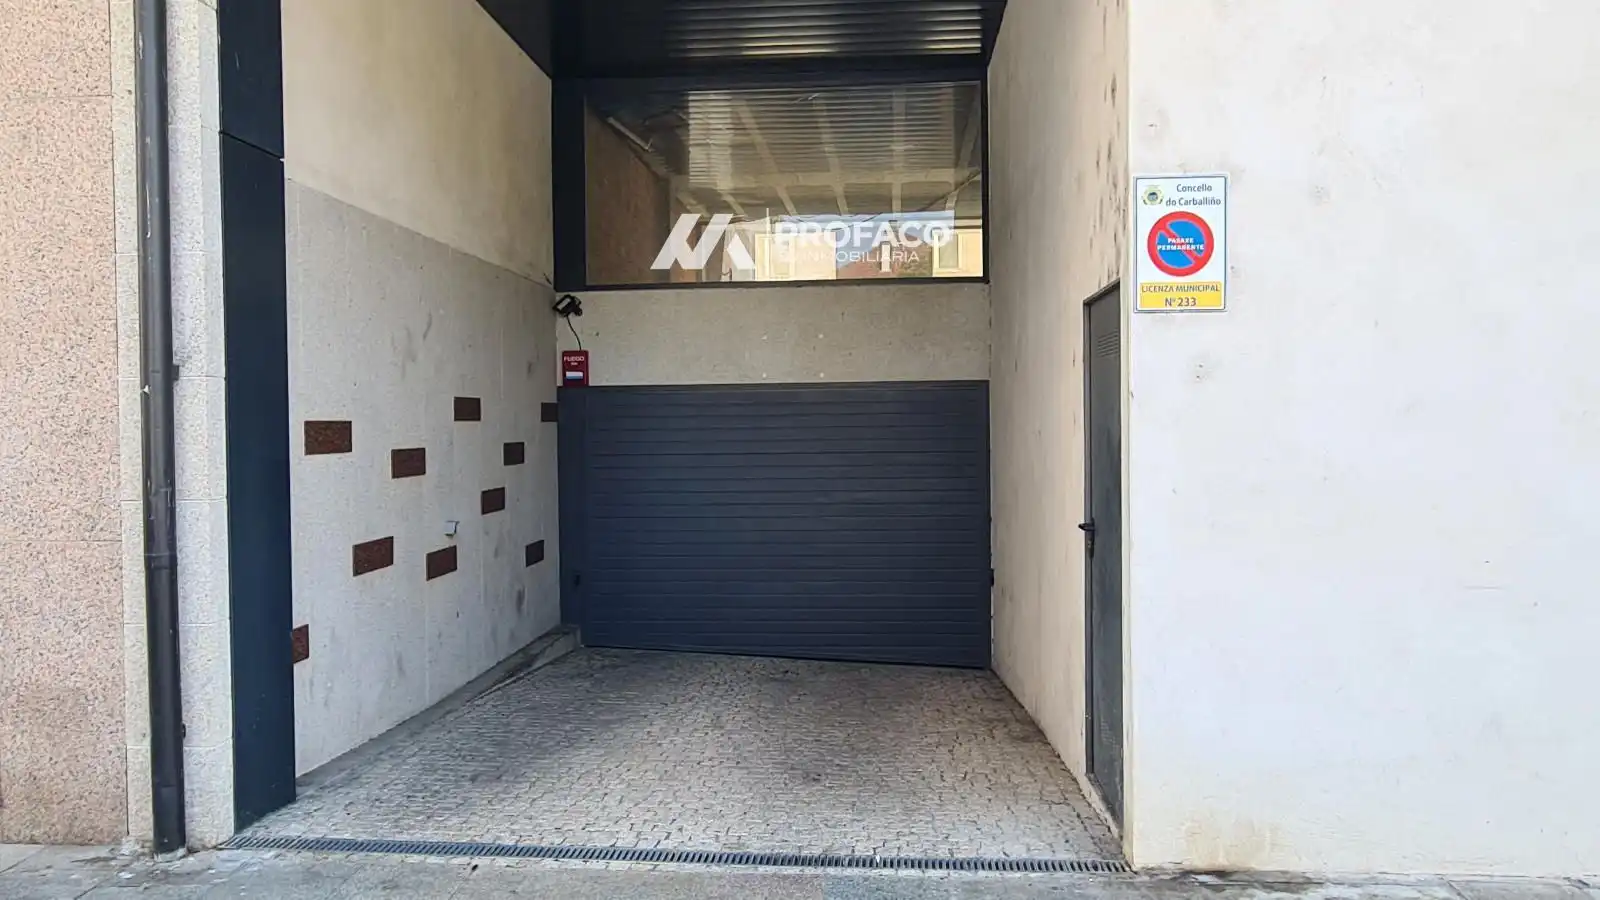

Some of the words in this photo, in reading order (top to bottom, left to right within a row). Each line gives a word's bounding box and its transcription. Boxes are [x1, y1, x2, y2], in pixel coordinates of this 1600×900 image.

[1176, 183, 1213, 193] Concello
[1165, 198, 1177, 206] do
[1178, 196, 1222, 206] Carballiño
[1141, 285, 1175, 293] LICENZA
[1175, 284, 1220, 292] MUNICIPAL
[1177, 297, 1197, 306] 233
